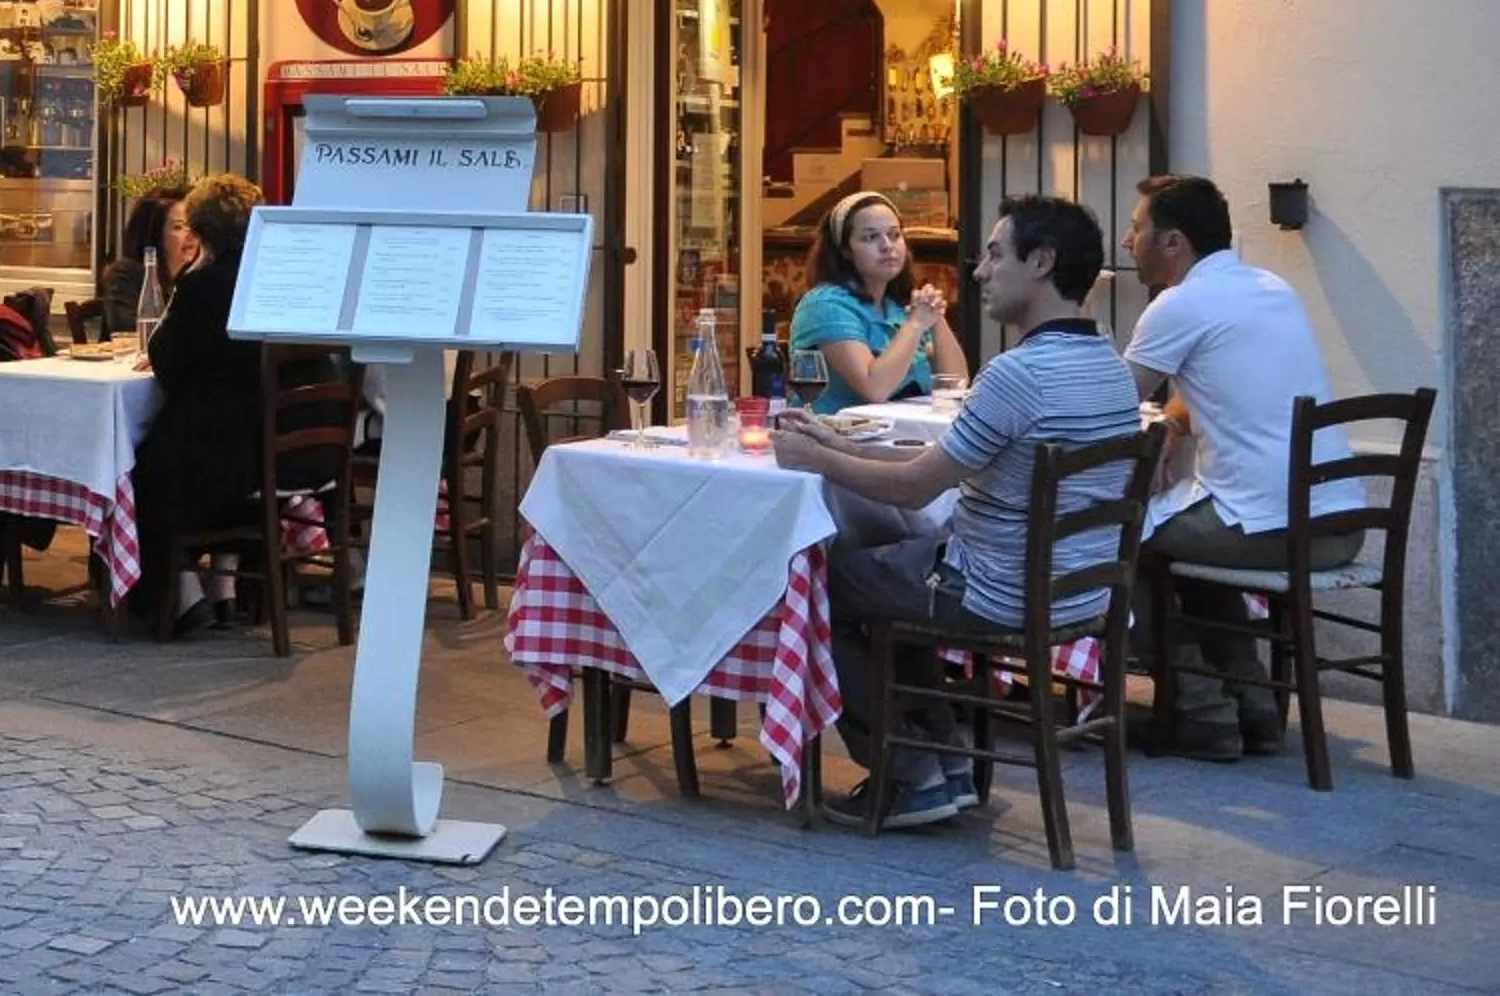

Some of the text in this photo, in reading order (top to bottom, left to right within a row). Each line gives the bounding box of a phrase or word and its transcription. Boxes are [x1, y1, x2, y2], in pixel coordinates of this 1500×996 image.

[315, 142, 521, 169] PASSAMI IL SALE
